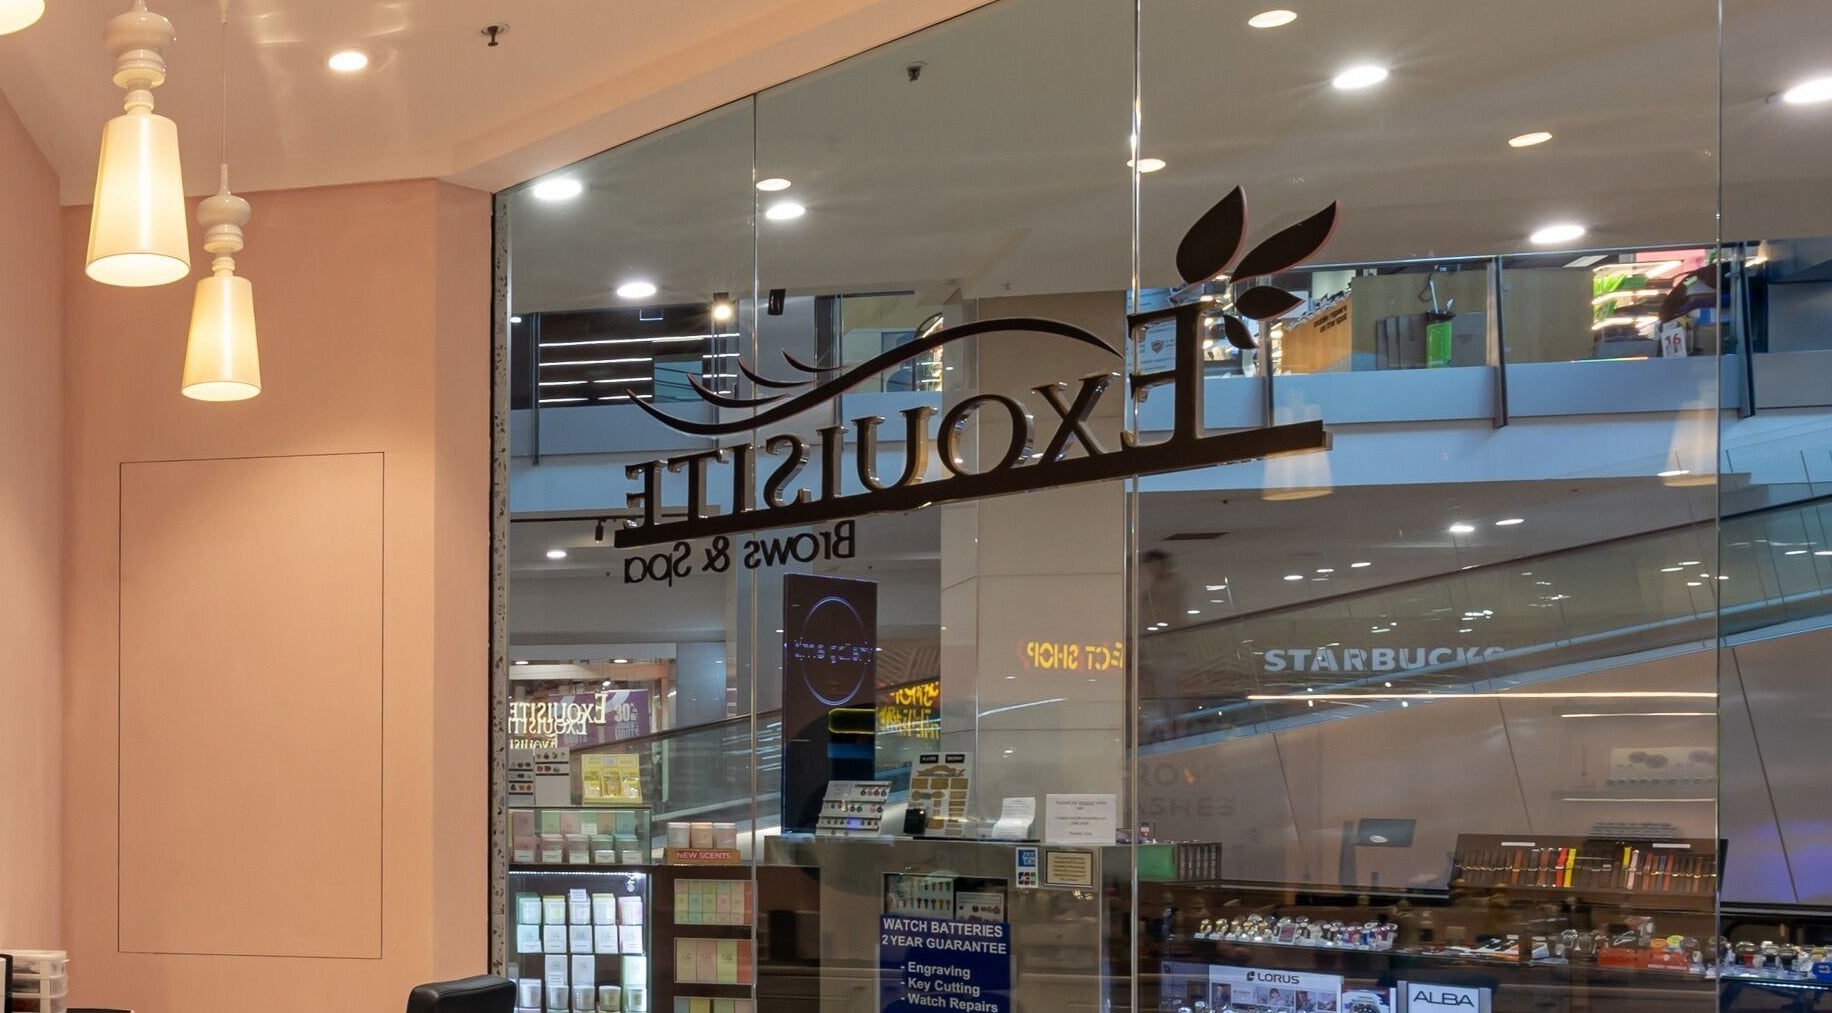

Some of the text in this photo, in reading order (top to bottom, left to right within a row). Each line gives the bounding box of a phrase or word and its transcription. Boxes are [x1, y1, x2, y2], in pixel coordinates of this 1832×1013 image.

[677, 851, 732, 861] NEW SCENTS
[883, 918, 1003, 937] WATCH BATTERIES
[882, 935, 1006, 954] 2 YEAR GUARANTEE
[908, 962, 970, 979] Engraving
[1257, 972, 1300, 985] LORUS
[908, 977, 930, 991] Key
[935, 980, 980, 997] Cutting
[908, 993, 946, 1008] Watch
[950, 998, 998, 1013] Repairs
[1412, 990, 1474, 1008] ALBA
